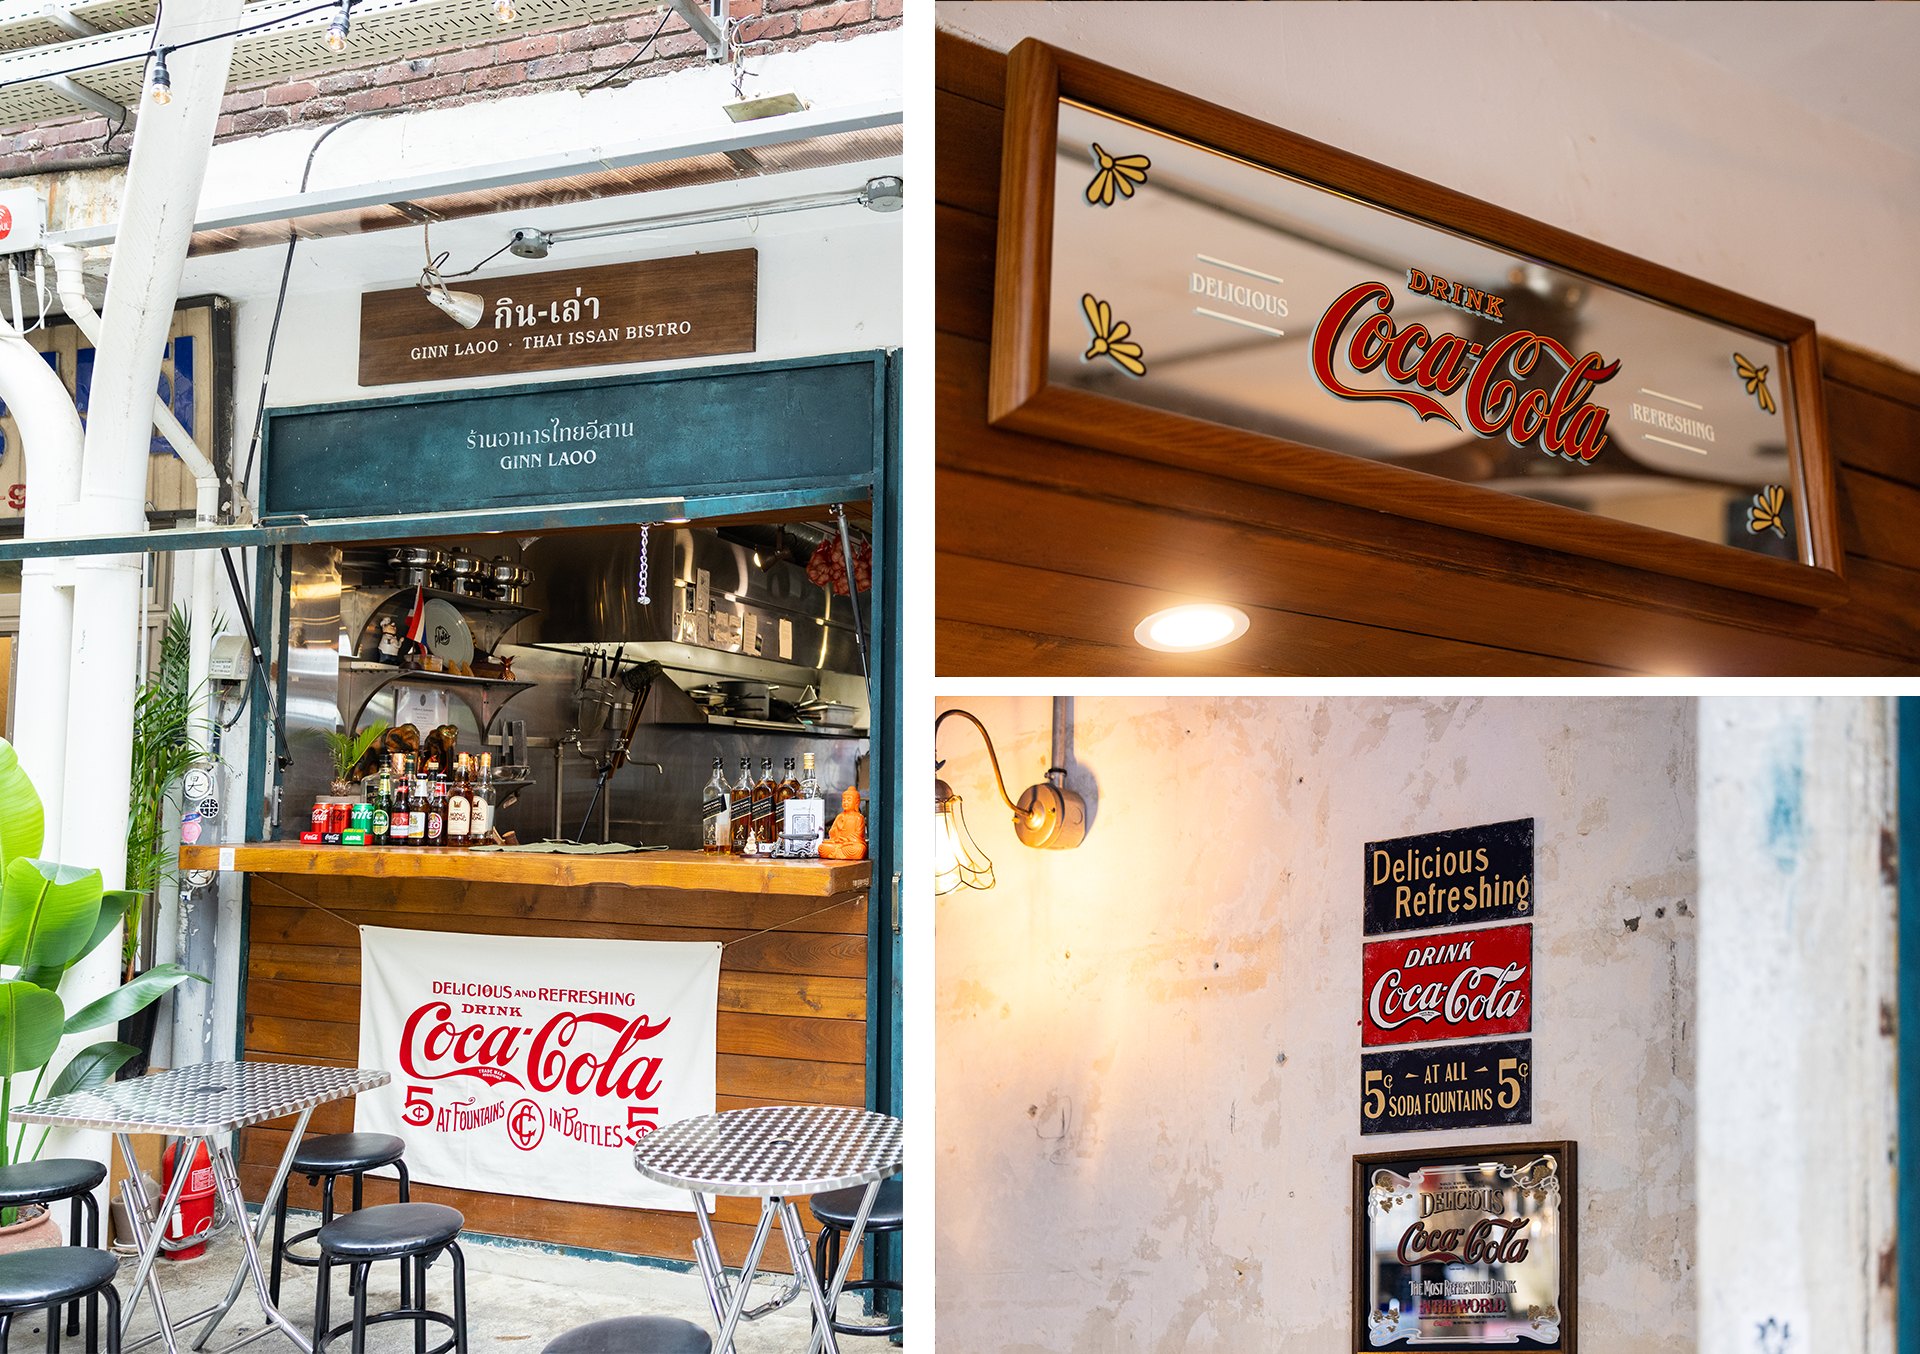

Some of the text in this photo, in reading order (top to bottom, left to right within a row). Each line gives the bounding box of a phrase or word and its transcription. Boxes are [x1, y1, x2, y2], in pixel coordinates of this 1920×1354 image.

[1190, 272, 1288, 318] DELICIOUS
[1407, 268, 1505, 322] DRINK
[411, 321, 691, 360] GINN LAOO THAI ISSAN BISTRO
[1308, 281, 1620, 466] Coca-Cola
[1631, 402, 1715, 443] REFRESHING
[500, 449, 597, 470] GINN LAOO
[1373, 847, 1489, 886] Delicious
[1395, 875, 1529, 919] Refreshing
[1403, 940, 1475, 968] DRINK
[432, 980, 635, 1007] DELICIOUS AND REFRESHING
[461, 1003, 522, 1017] DRINK
[1369, 961, 1528, 1029] Coca-Cola
[399, 1001, 671, 1101] Coca-Cola
[1424, 1062, 1468, 1084] AT ALL
[436, 1110, 452, 1132] AT
[1388, 1088, 1493, 1118] SODA FOUNTAINS
[549, 1106, 623, 1148] IN BOTTLES
[1420, 1189, 1504, 1218] DELICIOUS
[1397, 1218, 1530, 1266] Coca-Cola
[1409, 1278, 1517, 1297] THE MOST REFRESHING DRINK
[1431, 1299, 1457, 1315] THE
